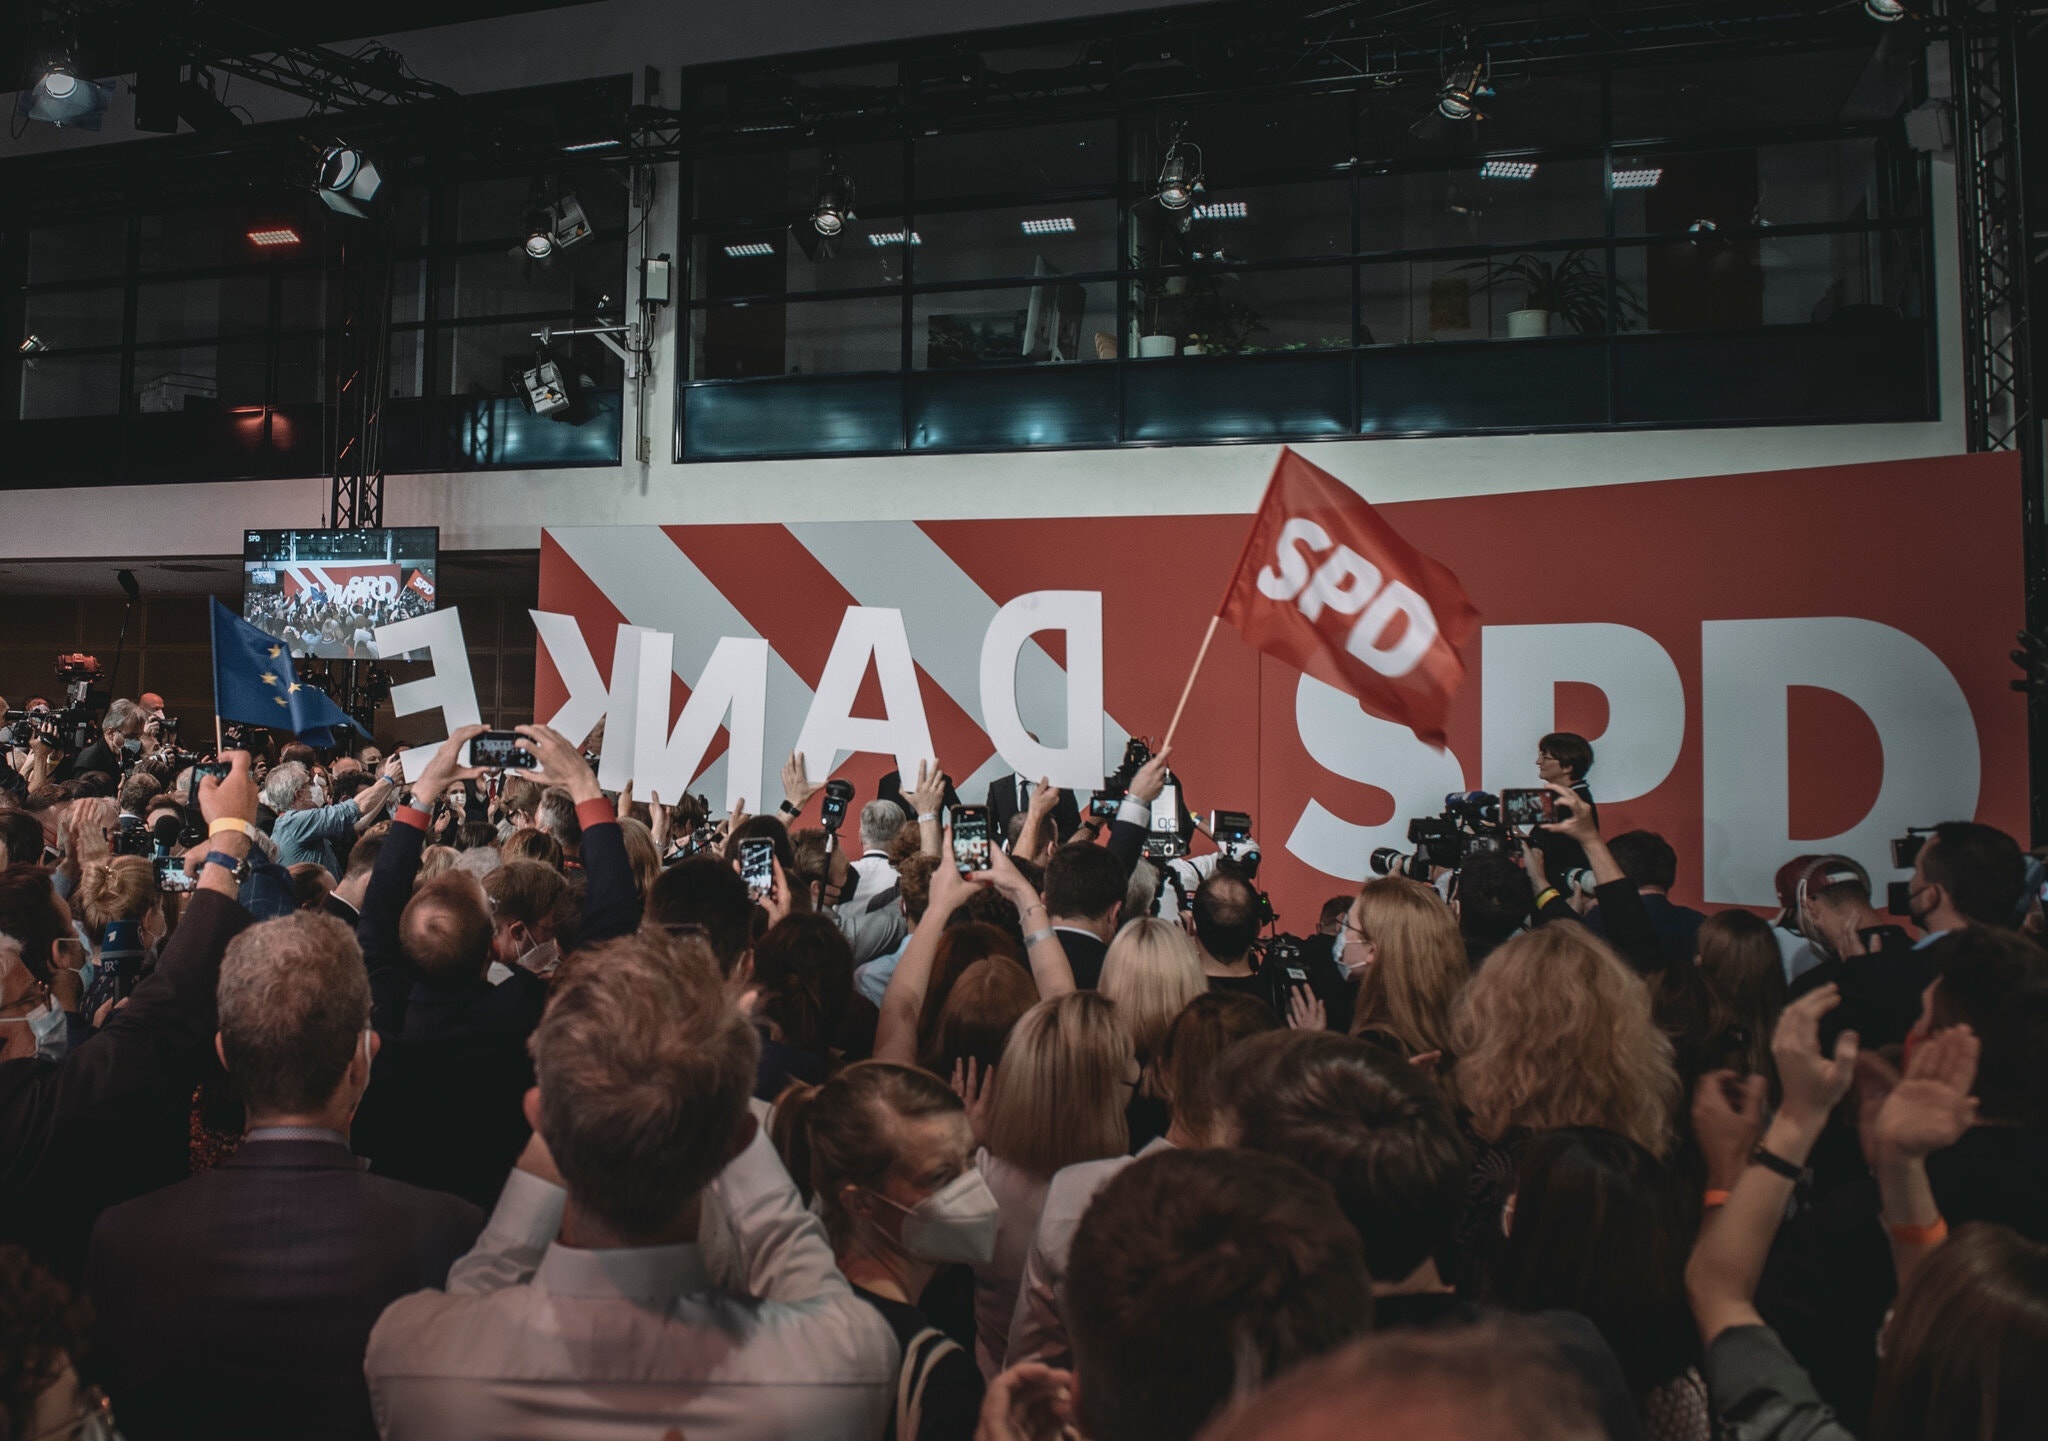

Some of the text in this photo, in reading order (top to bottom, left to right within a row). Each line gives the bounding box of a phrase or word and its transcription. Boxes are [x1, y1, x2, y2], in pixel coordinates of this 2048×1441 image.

[413, 576, 434, 595] SPD
[1256, 517, 1438, 678] SPD
[1286, 616, 1981, 909] SPD
